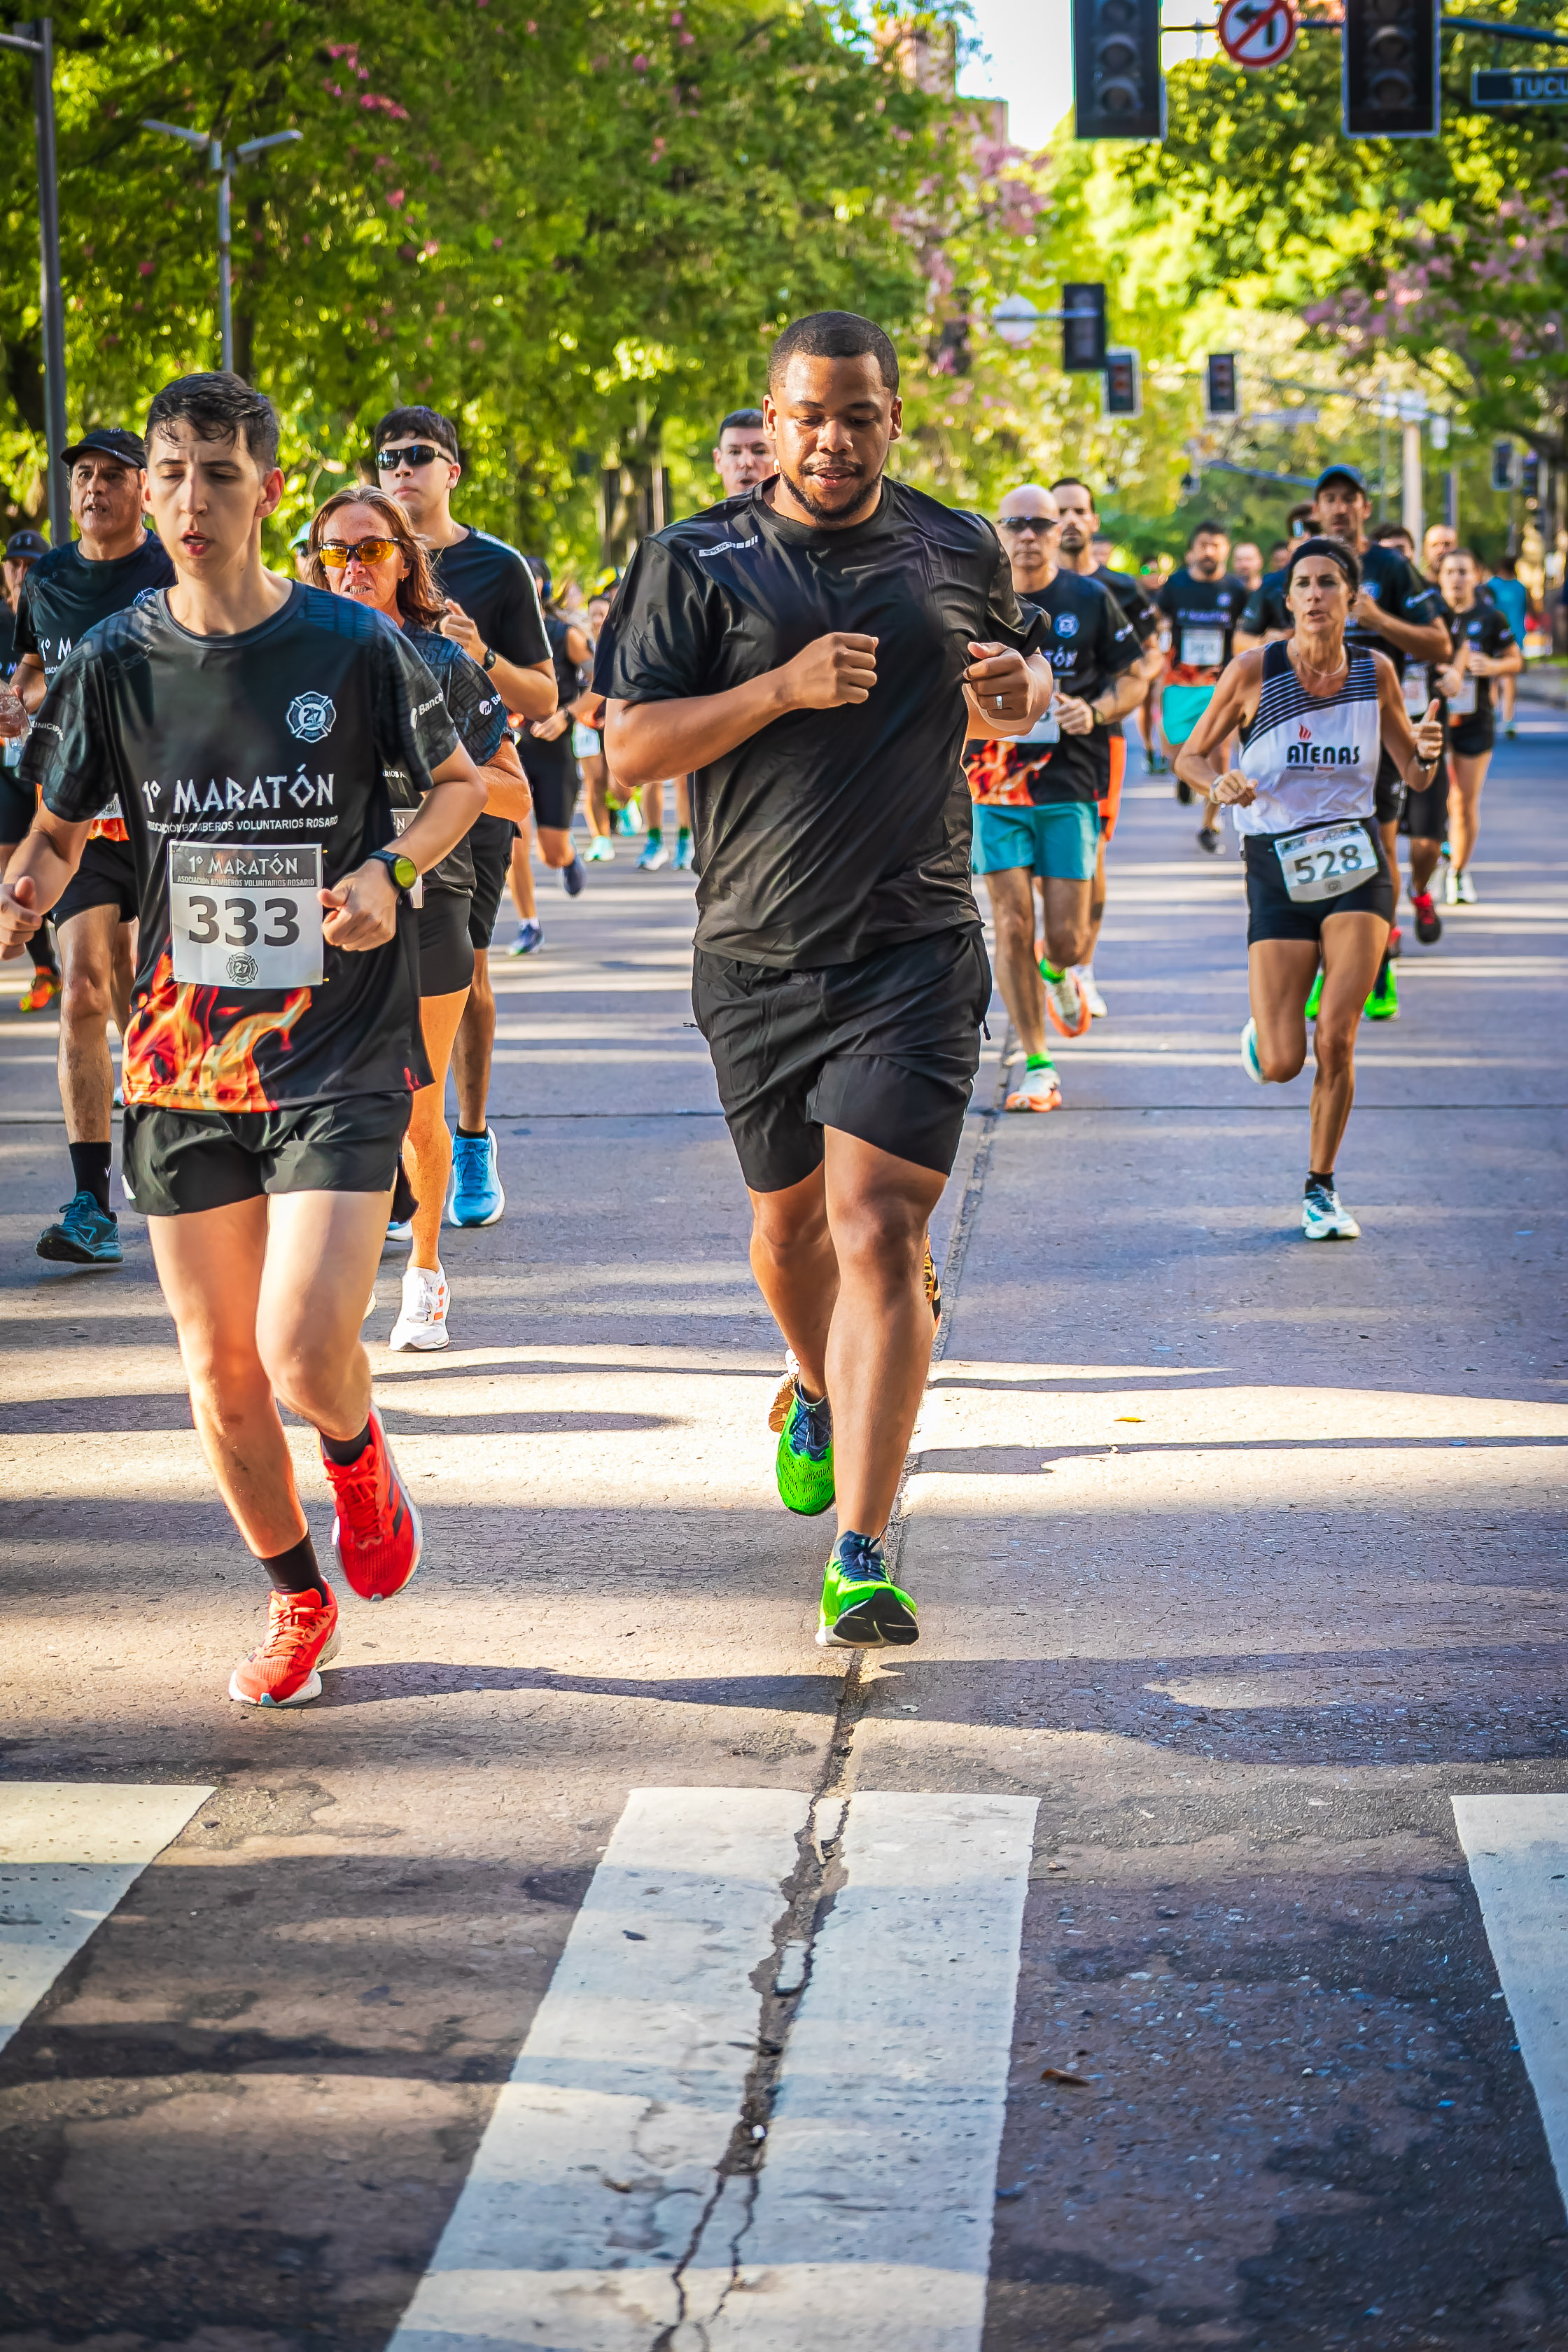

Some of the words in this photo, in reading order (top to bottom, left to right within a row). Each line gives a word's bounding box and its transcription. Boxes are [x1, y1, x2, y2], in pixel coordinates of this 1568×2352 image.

[303, 707, 322, 723] 27
[419, 692, 444, 715] Banco
[1287, 742, 1360, 765] ATENAS
[173, 763, 335, 813] MARATÓN
[183, 820, 234, 833] BOMBEROS
[237, 818, 304, 830] VOLUNTARIOS
[208, 852, 298, 876] MARATÓN
[1294, 844, 1362, 885] 528
[211, 877, 243, 887] BOMBEROS
[244, 878, 286, 888] VOLUNTARIOS
[287, 878, 314, 887] ROSARIO
[189, 895, 300, 947] 333
[234, 962, 248, 974] 27
